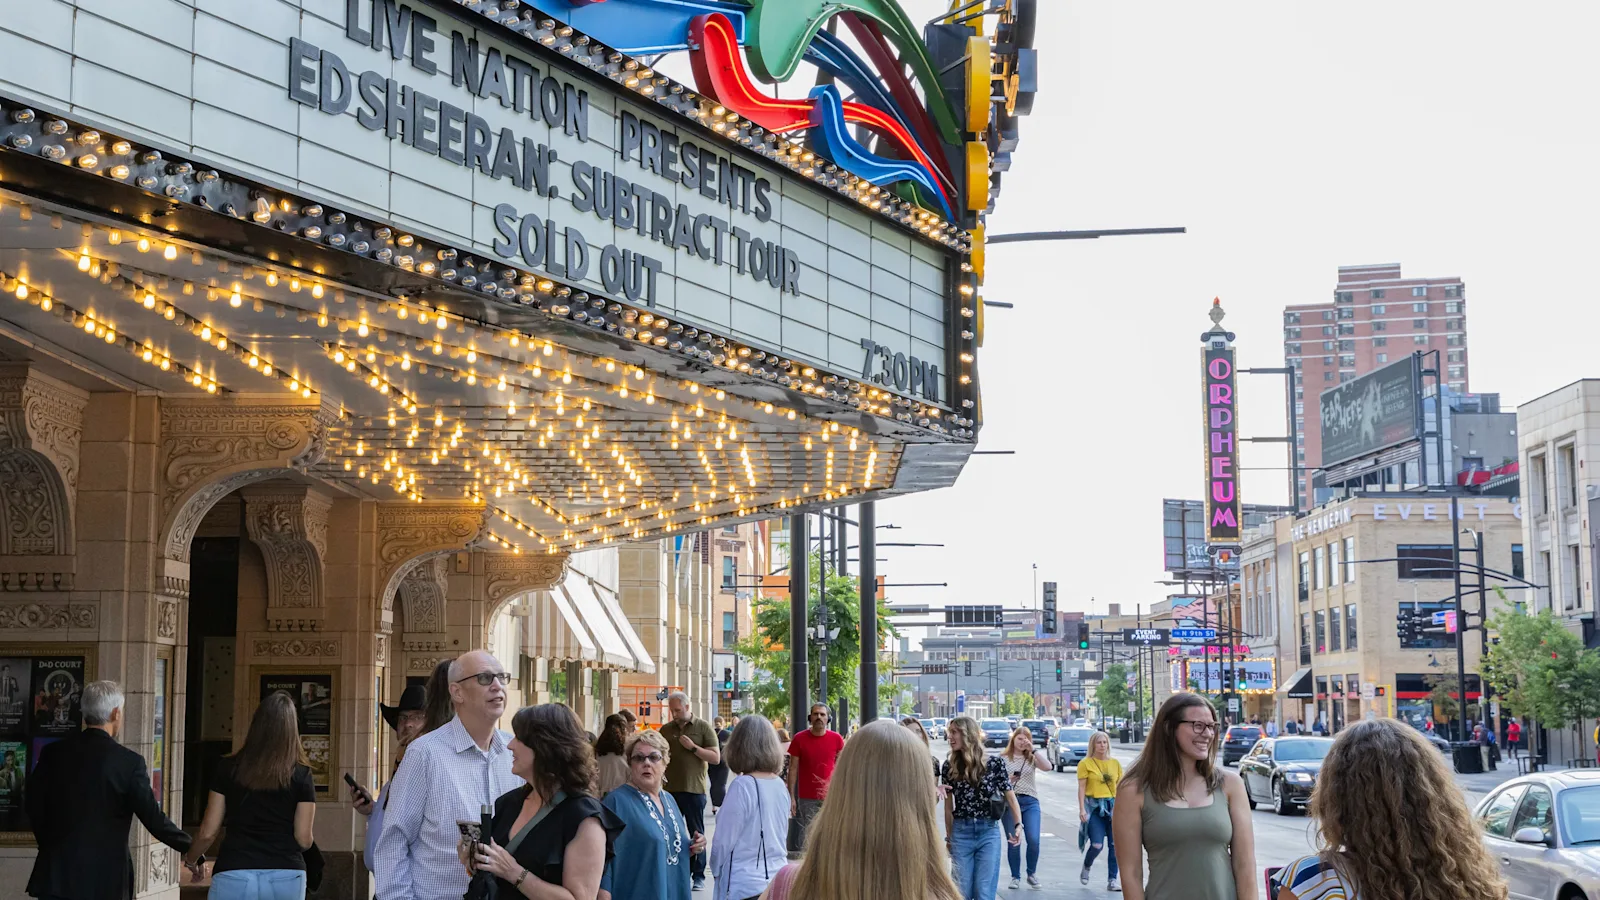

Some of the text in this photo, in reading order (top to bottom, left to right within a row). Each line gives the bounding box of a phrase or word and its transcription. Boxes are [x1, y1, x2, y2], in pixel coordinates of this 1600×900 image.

[346, 0, 772, 223] LIVE NATION PRESENTS
[288, 36, 801, 298] ED SHEERAN: SUBTRACT TOUR
[493, 203, 663, 309] SOLD OUT
[1208, 357, 1238, 527] ORPHEUM
[1290, 506, 1352, 543] THE HENNEPIN
[1373, 502, 1488, 521] EVENT
[54, 660, 82, 669] COURT
[1191, 669, 1219, 681] jaged
[303, 740, 329, 749] CROCE
